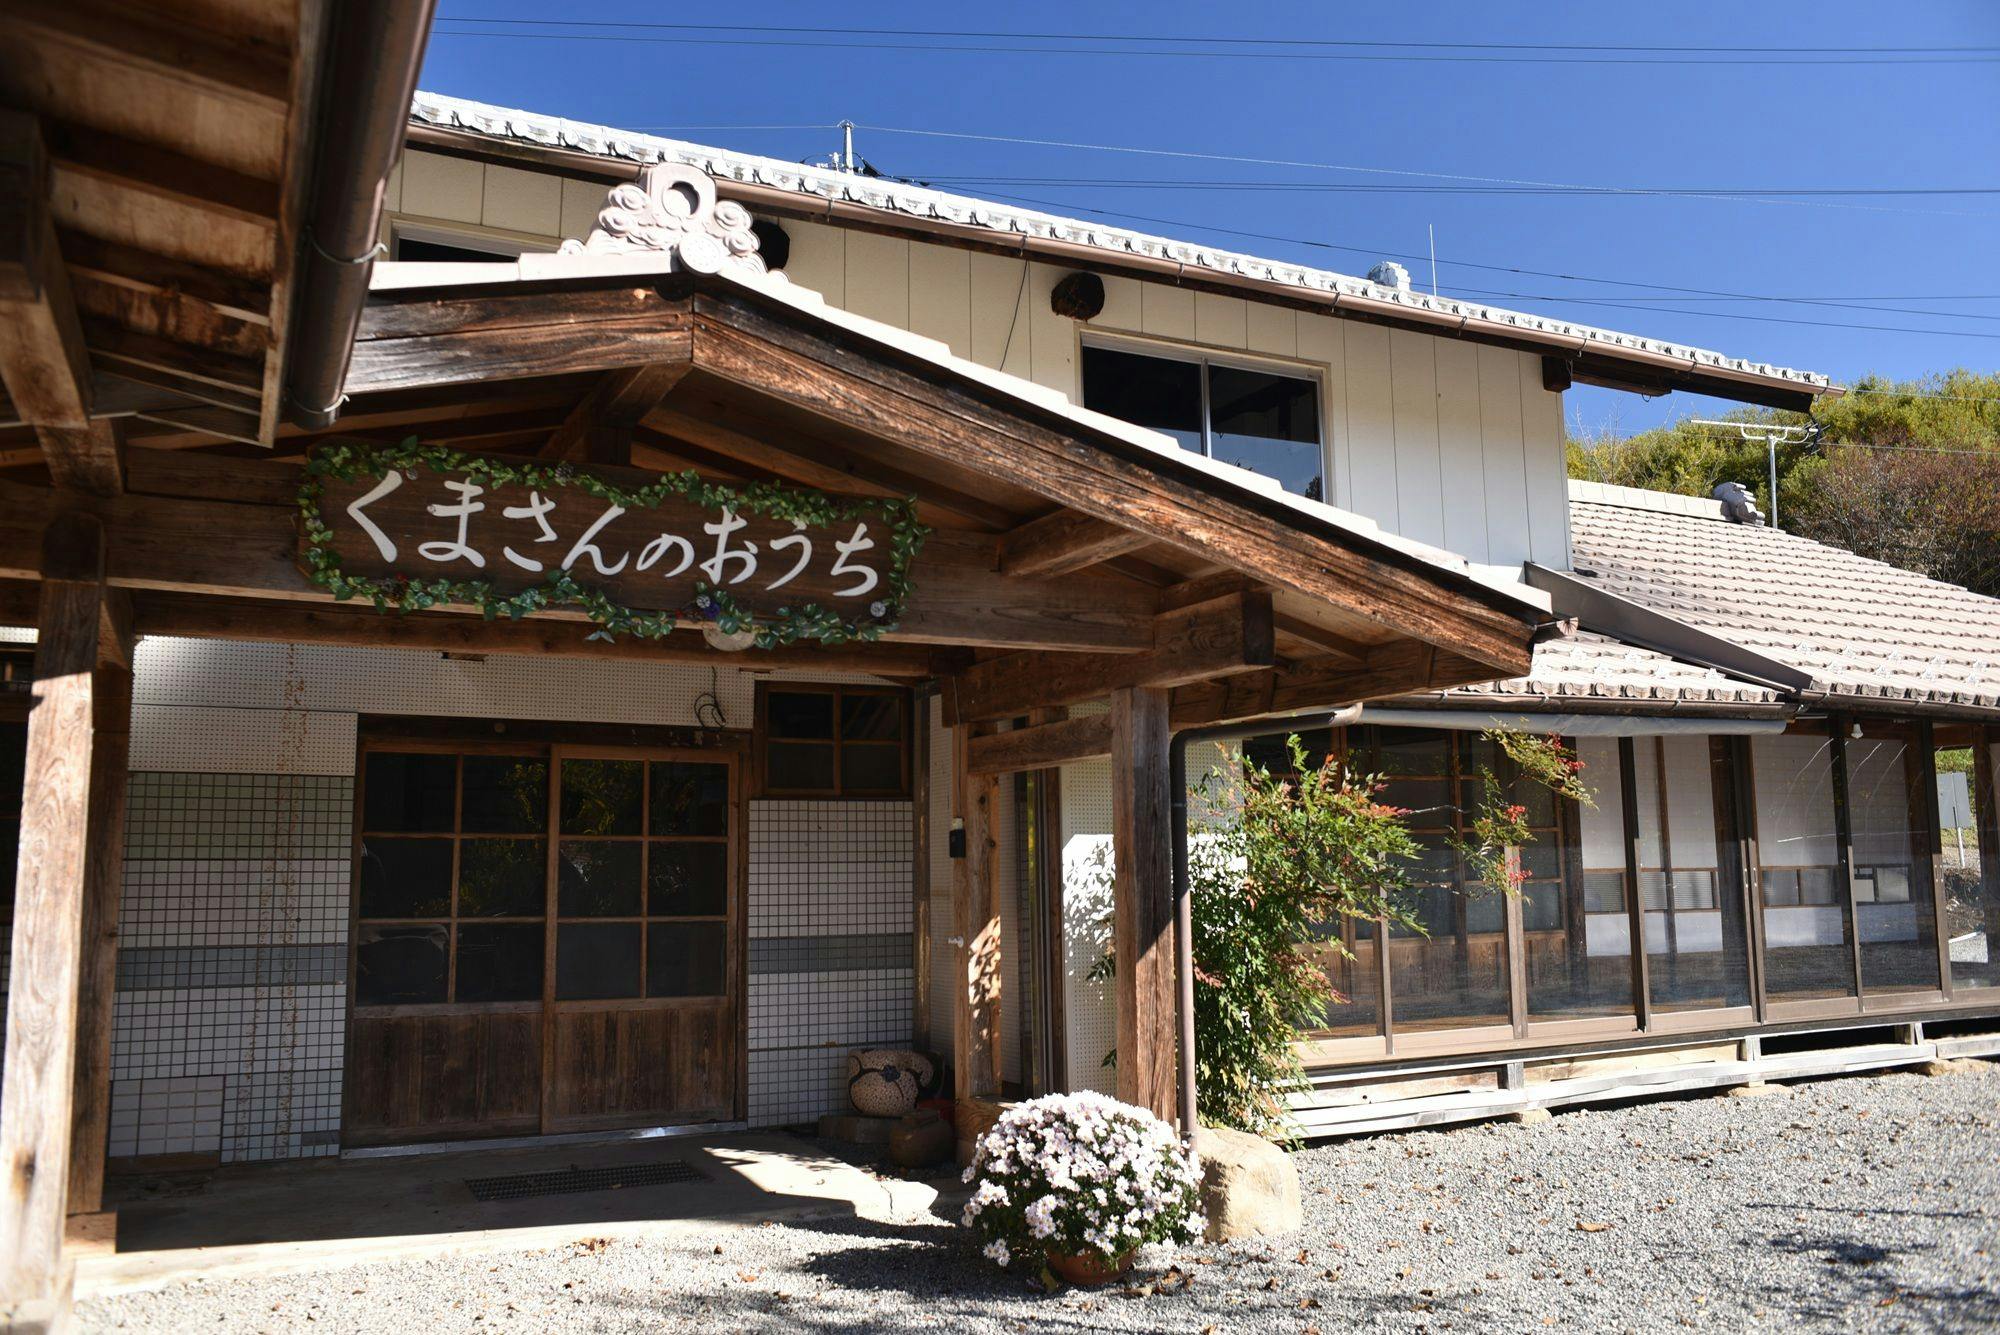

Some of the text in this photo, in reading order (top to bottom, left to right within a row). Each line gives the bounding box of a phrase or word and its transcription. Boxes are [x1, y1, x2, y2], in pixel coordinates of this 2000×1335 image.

[347, 469, 879, 597] くまさんのおうち
